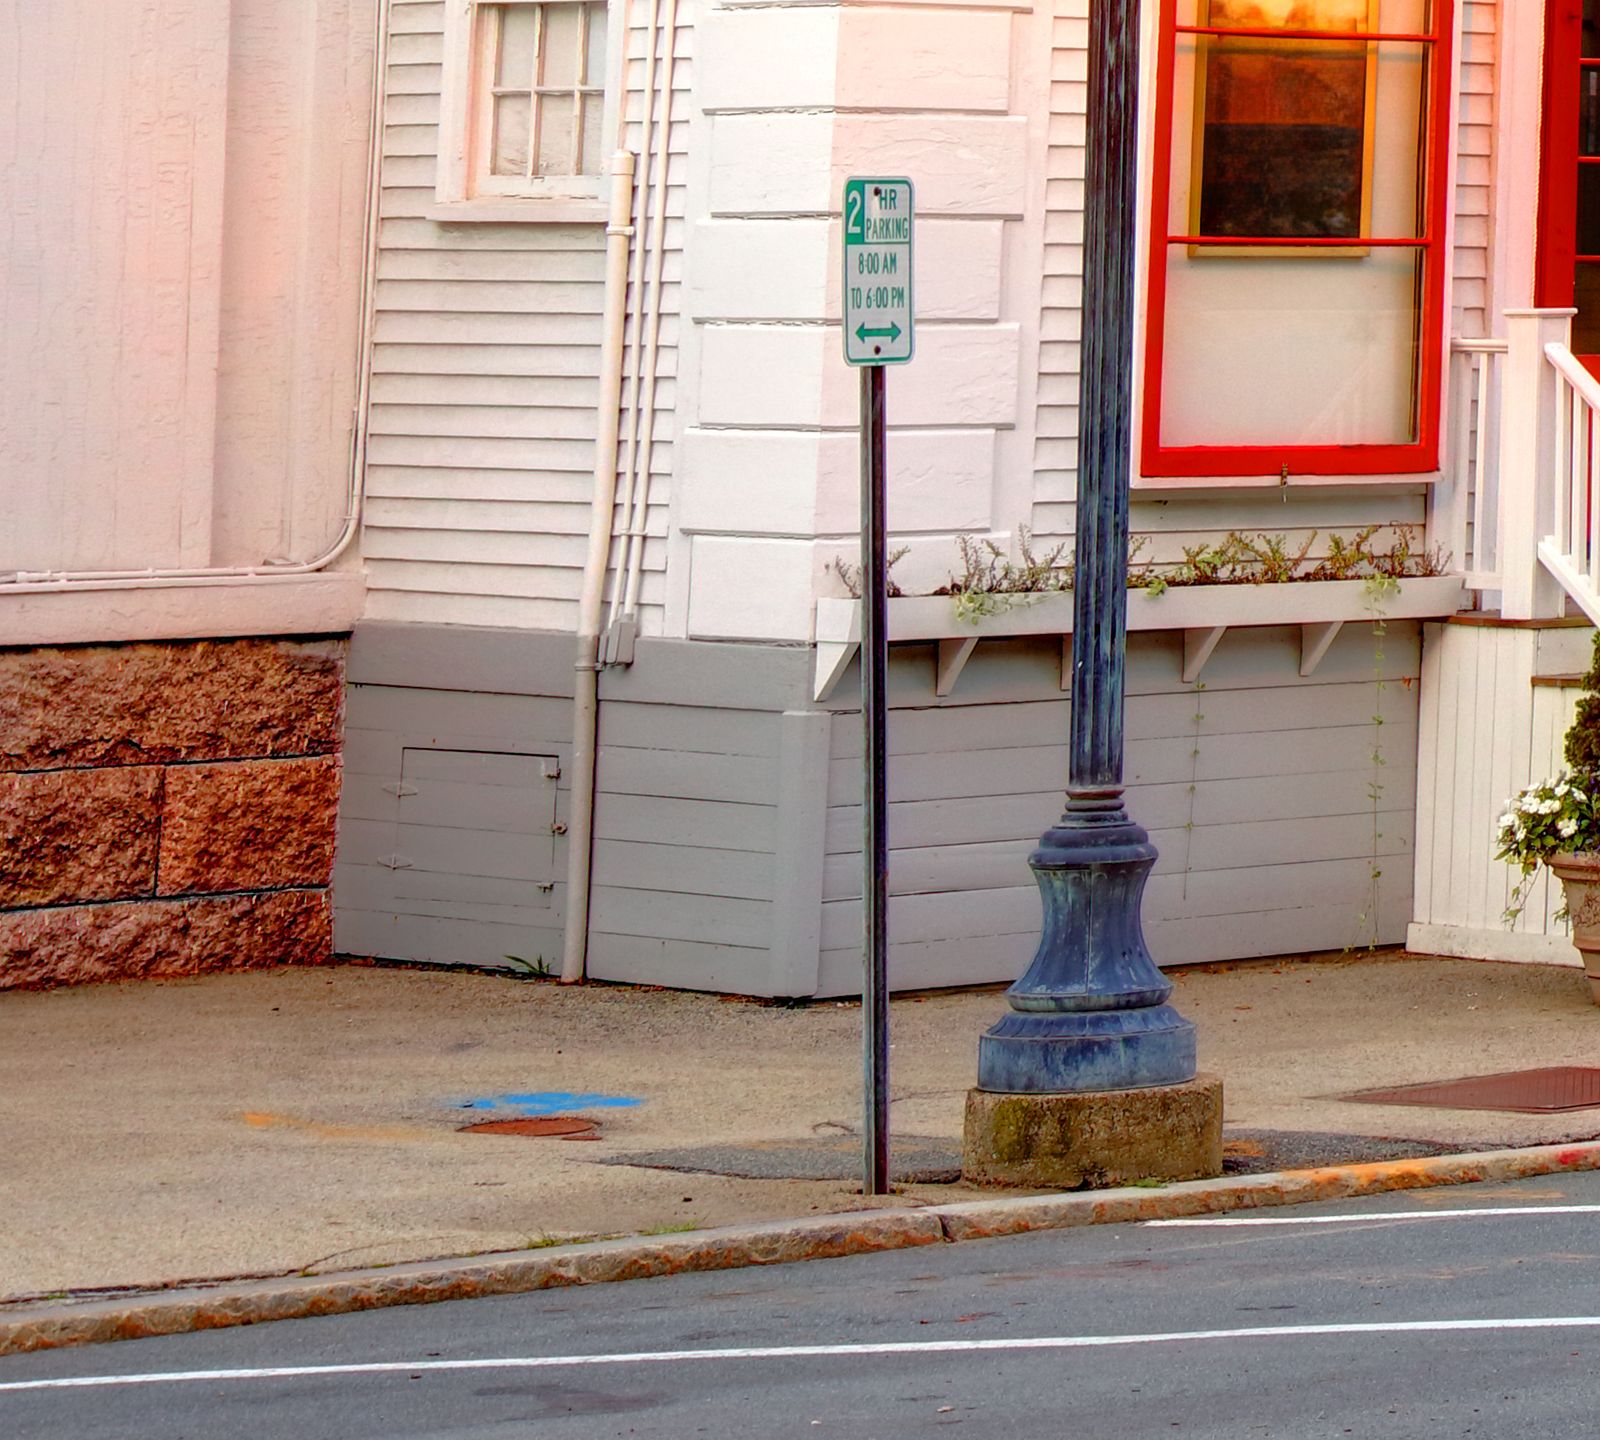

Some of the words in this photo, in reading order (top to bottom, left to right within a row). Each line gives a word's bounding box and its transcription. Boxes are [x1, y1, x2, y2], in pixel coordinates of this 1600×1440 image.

[847, 189, 862, 234] 2
[879, 188, 897, 210] HR
[865, 217, 909, 240] PARKING
[858, 252, 879, 275] 8:00
[882, 252, 897, 274] AM
[851, 287, 862, 310] TO
[866, 286, 889, 309] 6:00
[891, 286, 905, 309] PM
